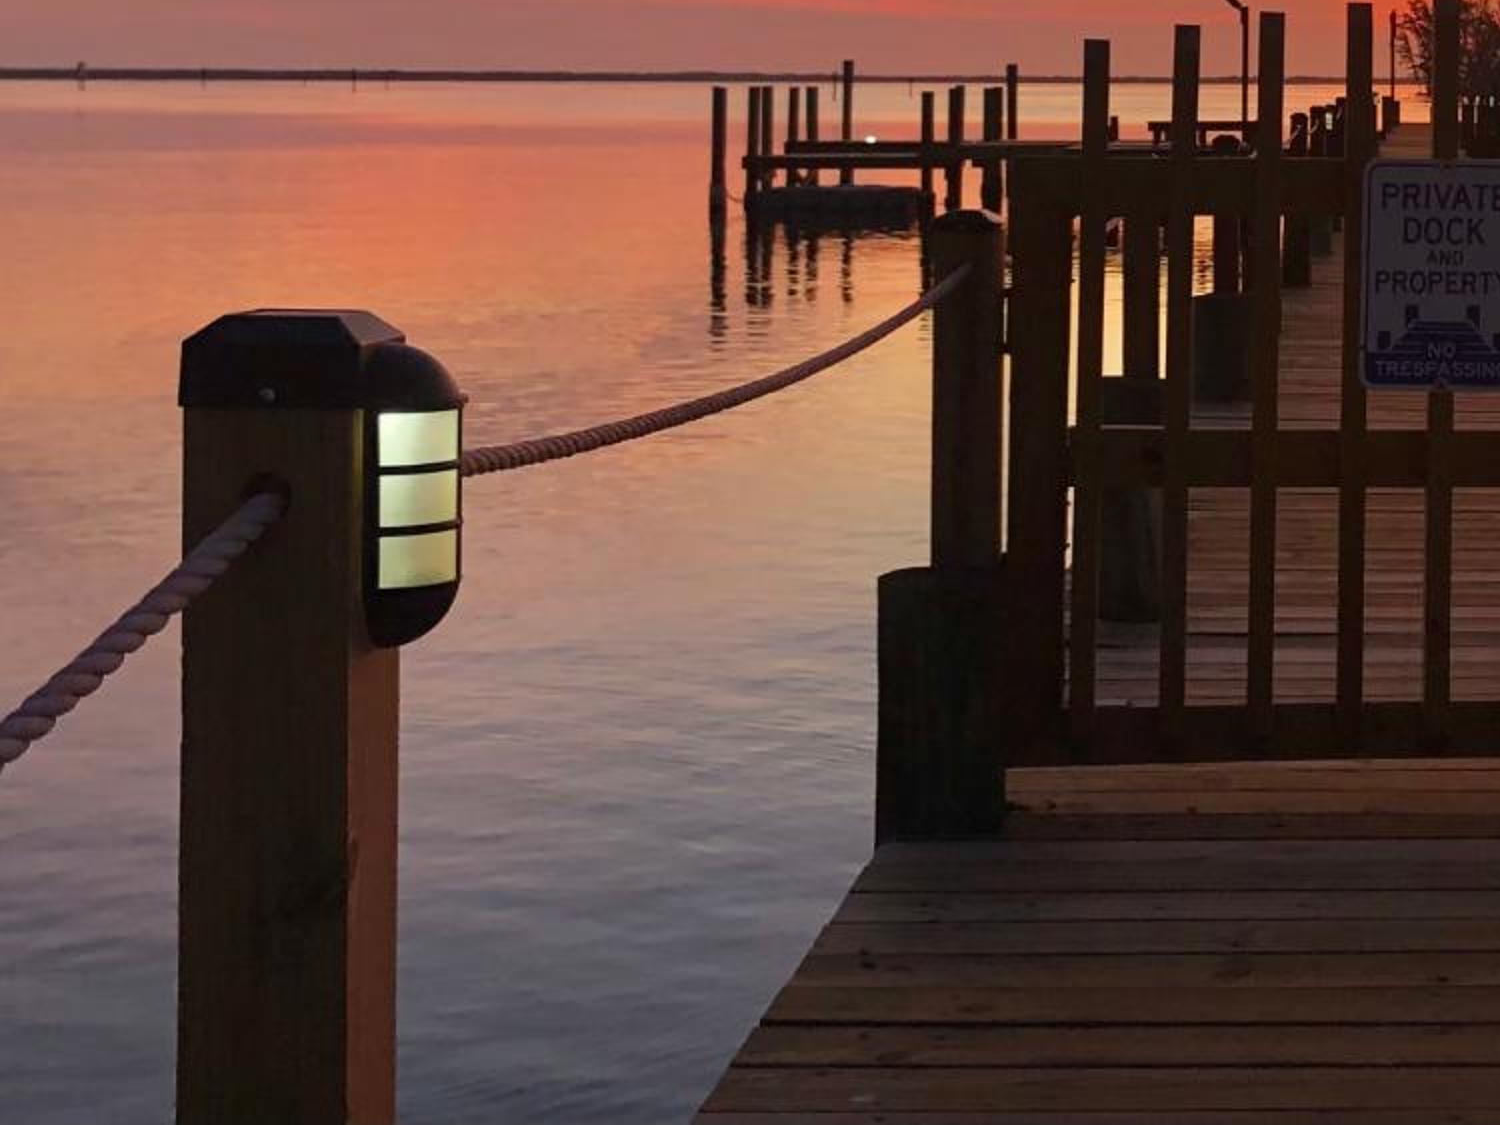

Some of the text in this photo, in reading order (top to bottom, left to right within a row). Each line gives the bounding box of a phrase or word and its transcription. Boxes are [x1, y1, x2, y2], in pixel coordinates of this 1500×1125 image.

[1402, 217, 1486, 245] DOCK
[1426, 250, 1464, 266] AND
[1427, 343, 1457, 359] NO
